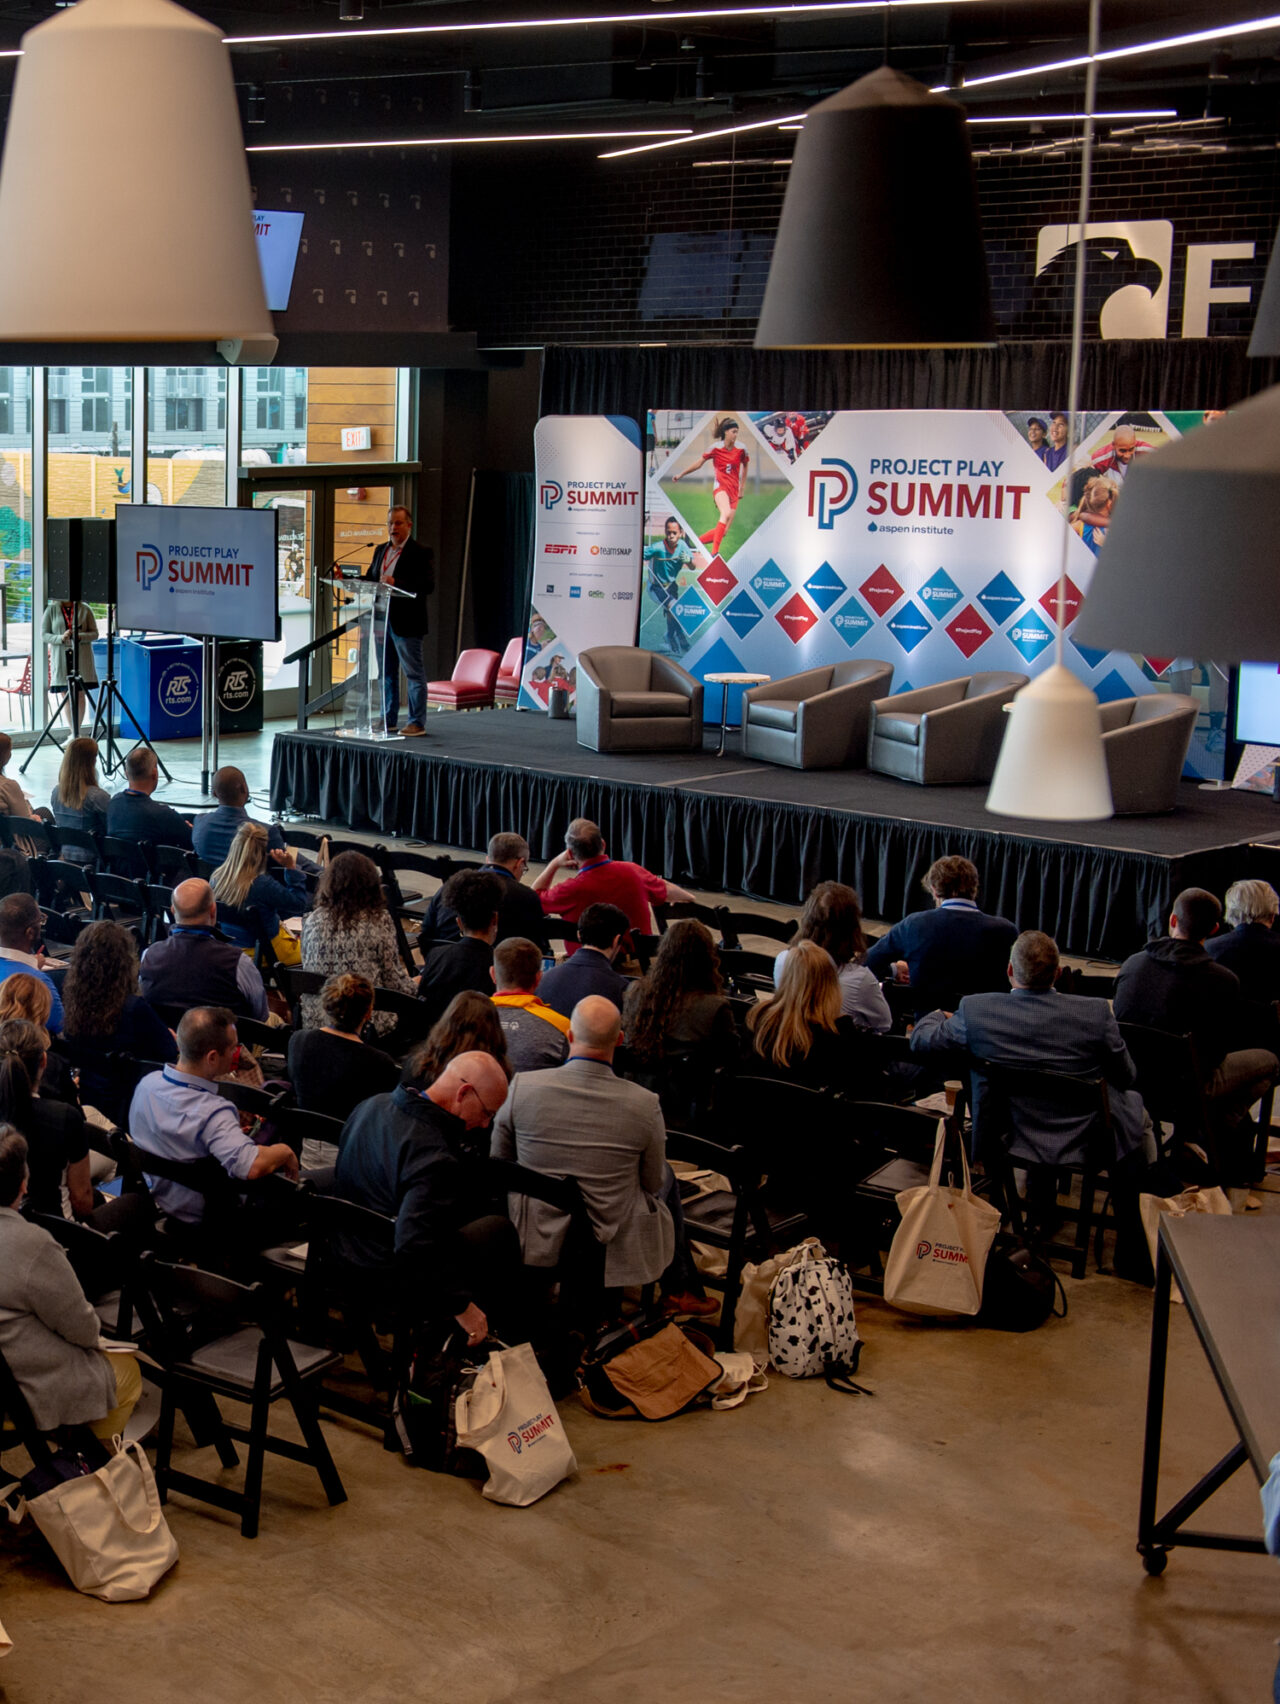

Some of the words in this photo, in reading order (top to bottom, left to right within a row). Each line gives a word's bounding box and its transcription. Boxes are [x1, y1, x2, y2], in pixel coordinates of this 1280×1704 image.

[870, 458, 953, 476] PROJECT
[957, 460, 1004, 477] PLAY
[567, 490, 638, 505] SUMMIT
[866, 481, 1030, 520] SUMMIT
[879, 524, 910, 534] aspen
[911, 524, 954, 535] institute
[168, 545, 212, 558] PROJECT
[214, 548, 239, 559] PLAY
[544, 544, 577, 555] ESPN
[168, 560, 254, 587] SUMMIT
[167, 676, 191, 696] RTS
[224, 671, 248, 691] RTS
[165, 696, 192, 704] rts.com
[933, 1249, 968, 1263] SUMM
[521, 1414, 554, 1442] SUMMIT
